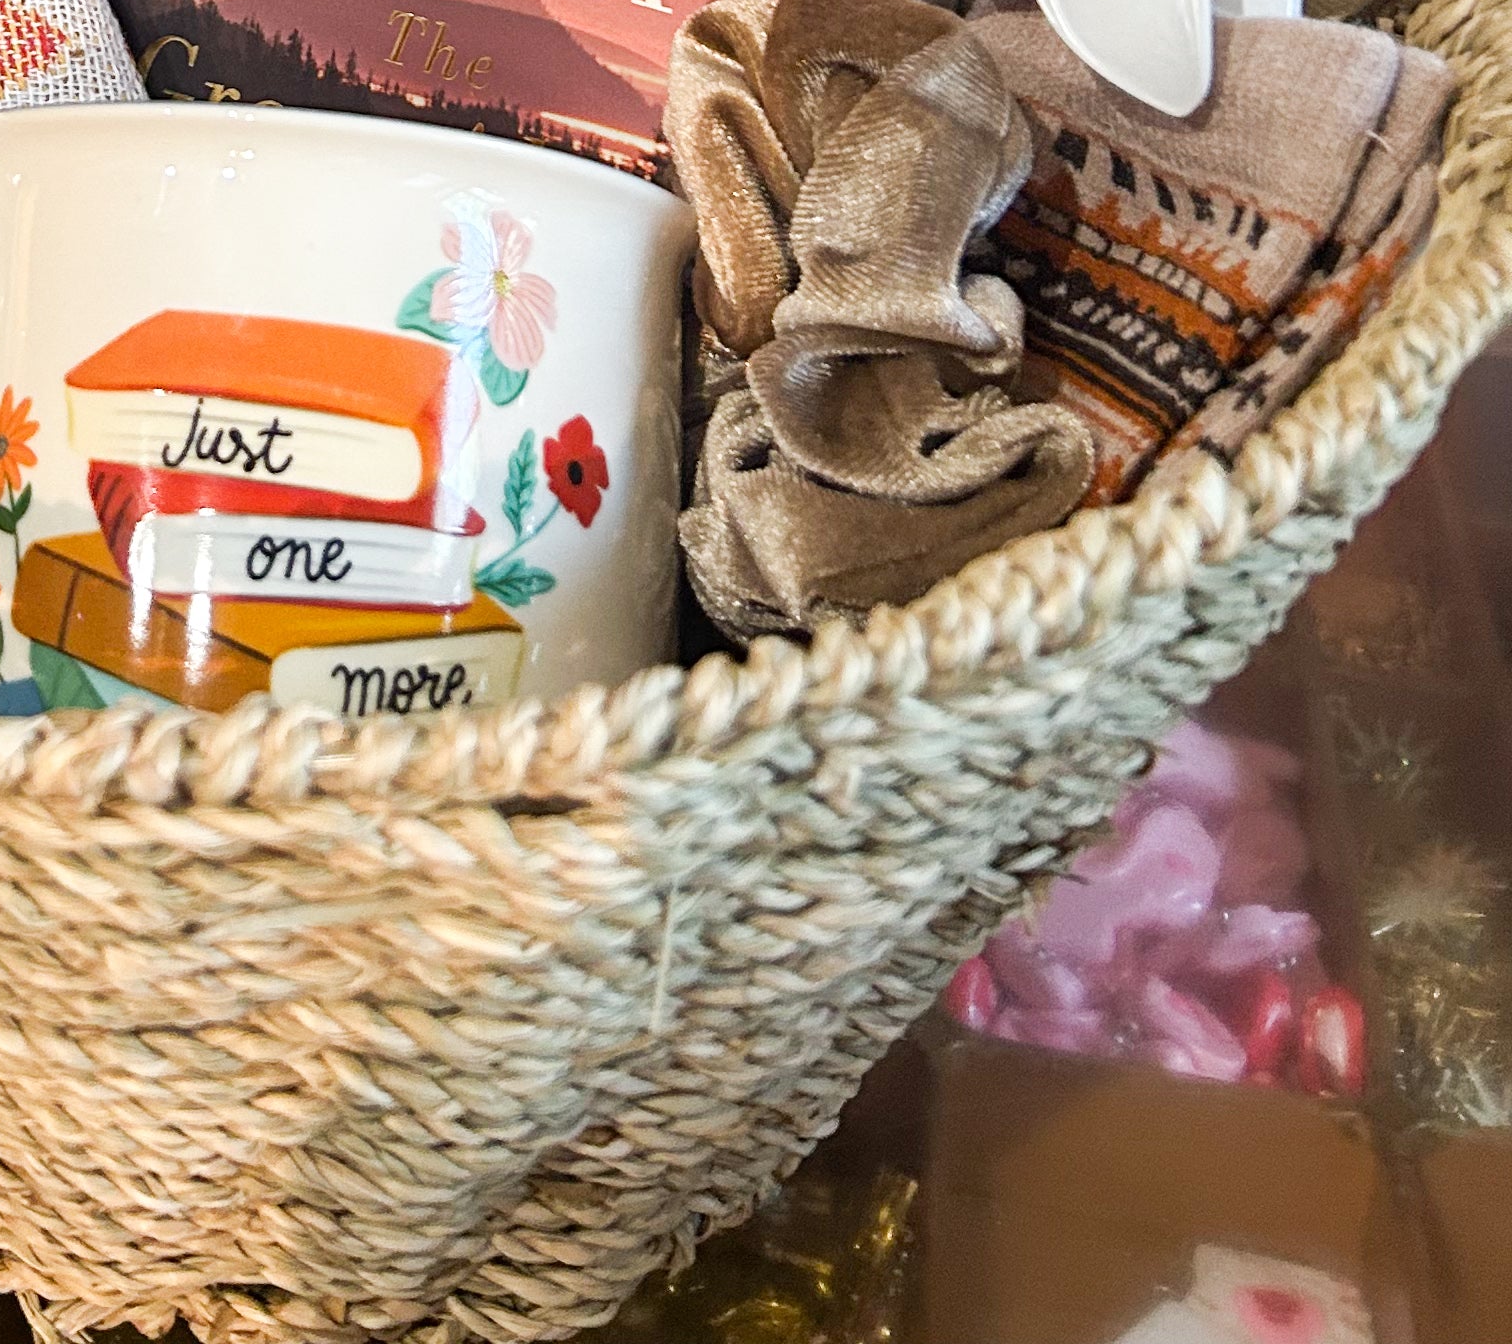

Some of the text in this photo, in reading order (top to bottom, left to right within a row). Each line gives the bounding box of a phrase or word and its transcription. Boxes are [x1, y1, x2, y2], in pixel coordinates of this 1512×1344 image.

[384, 9, 493, 90] The
[161, 396, 294, 474] Just
[246, 535, 353, 582] one
